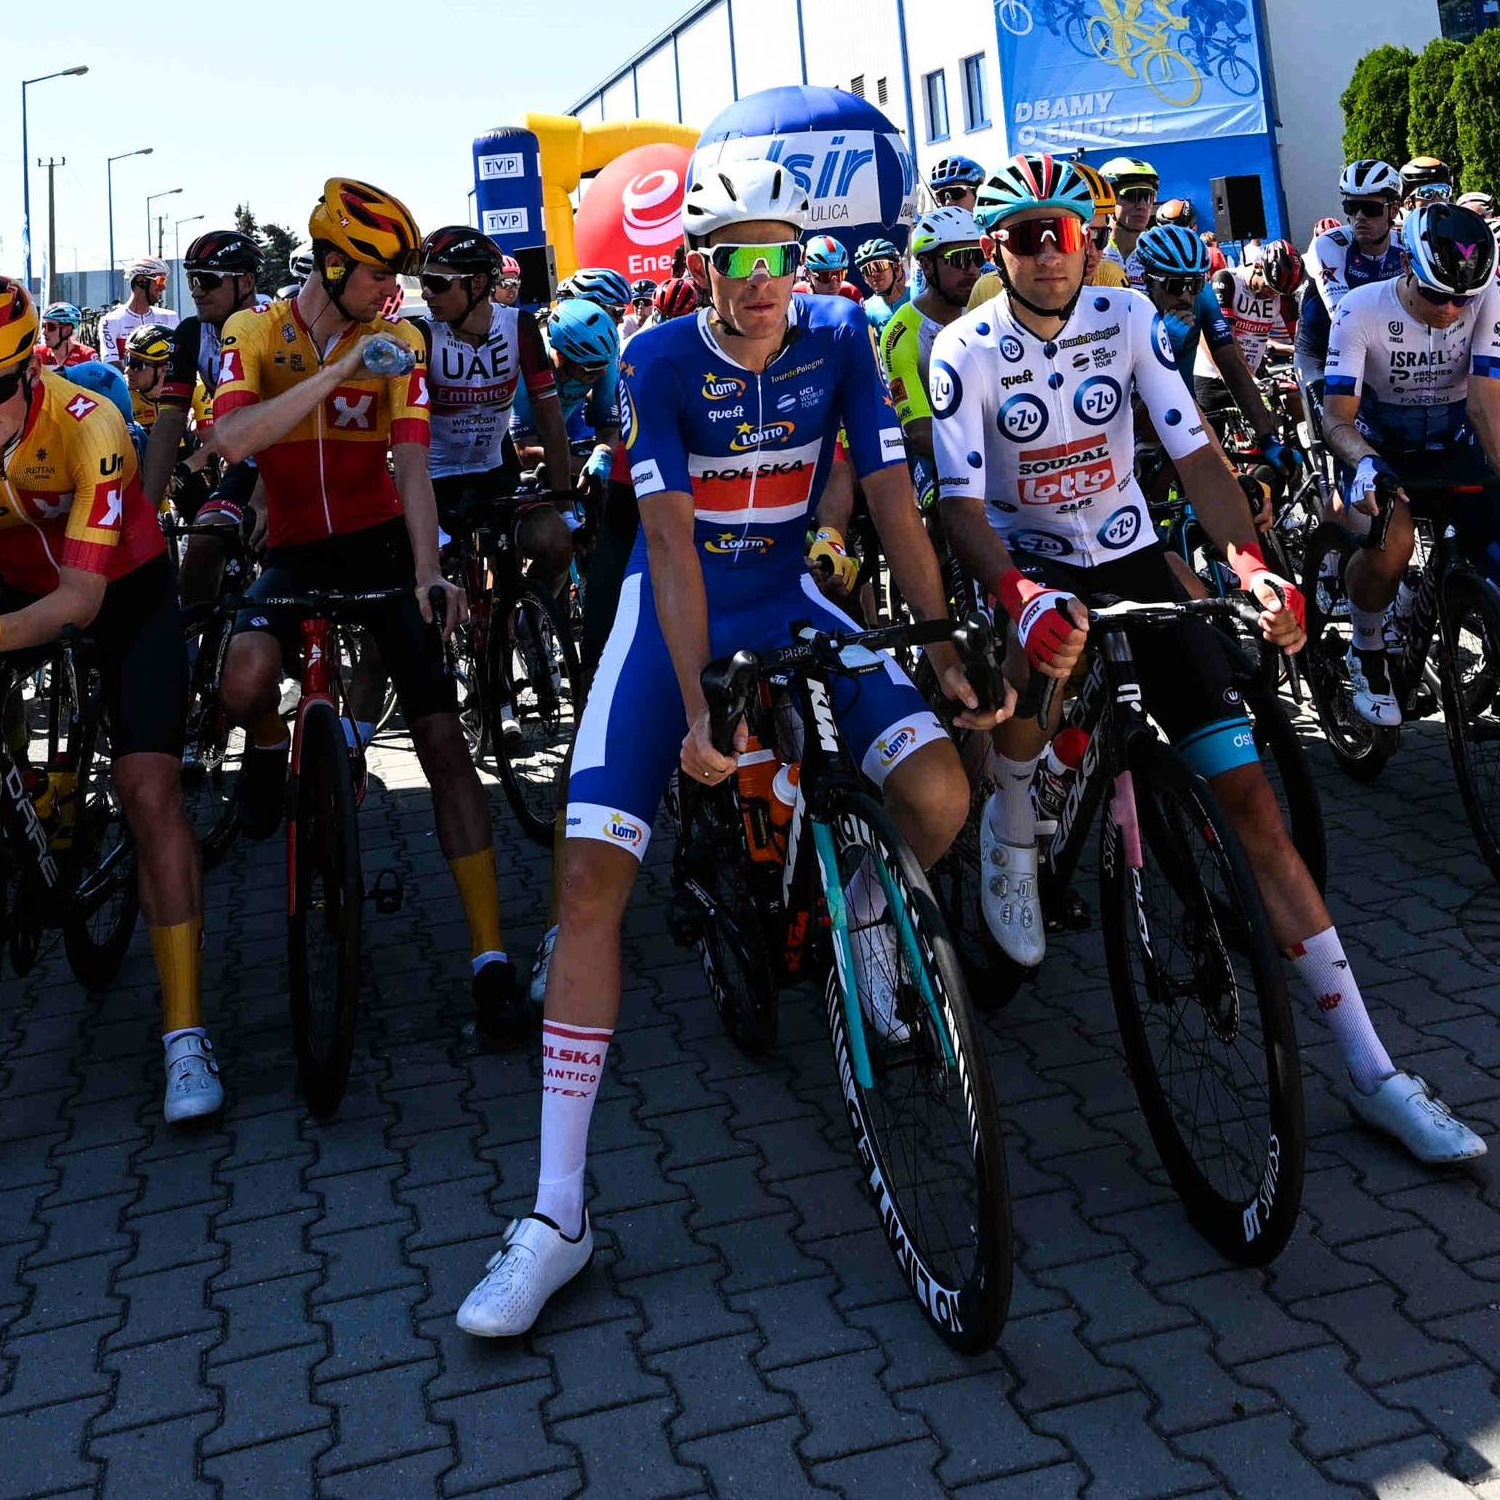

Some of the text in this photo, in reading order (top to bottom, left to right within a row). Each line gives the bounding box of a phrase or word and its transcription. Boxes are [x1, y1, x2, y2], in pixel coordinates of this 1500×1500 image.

[1015, 91, 1116, 123] DBAMY
[1018, 111, 1154, 145] O EMOCJE
[483, 158, 515, 175] TVP
[487, 211, 521, 231] TVP
[1238, 297, 1274, 319] UAE
[442, 341, 510, 381] UAE
[1004, 342, 1019, 358] PZU
[1093, 351, 1117, 364] WORLD
[1390, 350, 1447, 367] ISRAEL
[1001, 347, 1106, 389] quest UCI
[1094, 359, 1113, 369] TOUR
[1411, 369, 1453, 379] PREMIER
[436, 384, 509, 406] Emirates
[709, 381, 737, 396] LOTTO
[708, 385, 814, 423] quest UCI
[1086, 389, 1114, 414] PZU
[1008, 406, 1038, 430] PZU
[701, 460, 805, 483] POLSKA
[1019, 446, 1109, 476] SOUDAL
[1109, 515, 1135, 542] PZU
[806, 680, 840, 753] KTM
[881, 730, 909, 760] LOTTO
[612, 823, 637, 841] LOTTO
